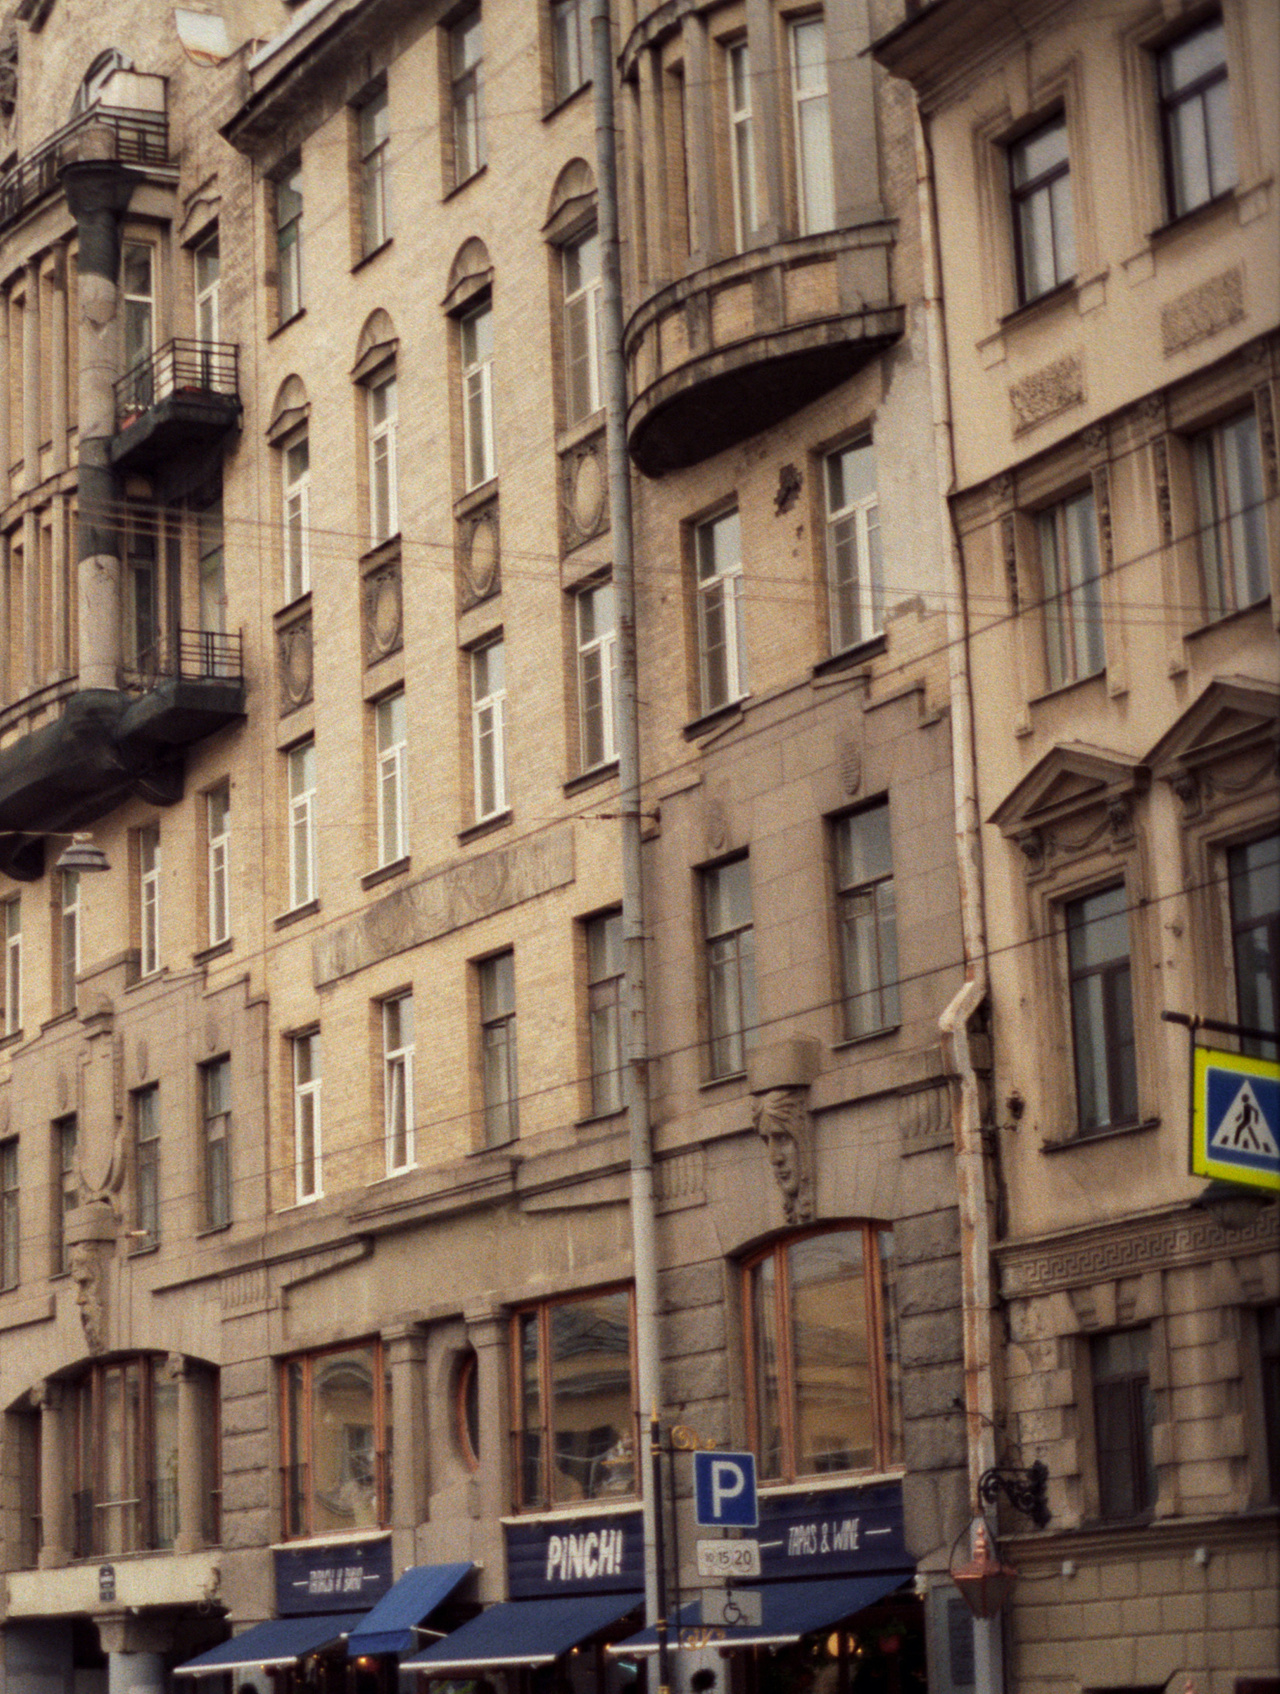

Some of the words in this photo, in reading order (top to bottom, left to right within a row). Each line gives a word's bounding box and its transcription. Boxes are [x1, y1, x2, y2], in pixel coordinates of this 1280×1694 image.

[711, 1460, 745, 1518] P
[546, 1529, 623, 1581] PINCH!
[718, 1551, 730, 1564] 15
[734, 1549, 752, 1566] 20
[787, 1523, 818, 1556] TAPAS
[820, 1522, 831, 1554] &
[832, 1517, 860, 1552] WINE
